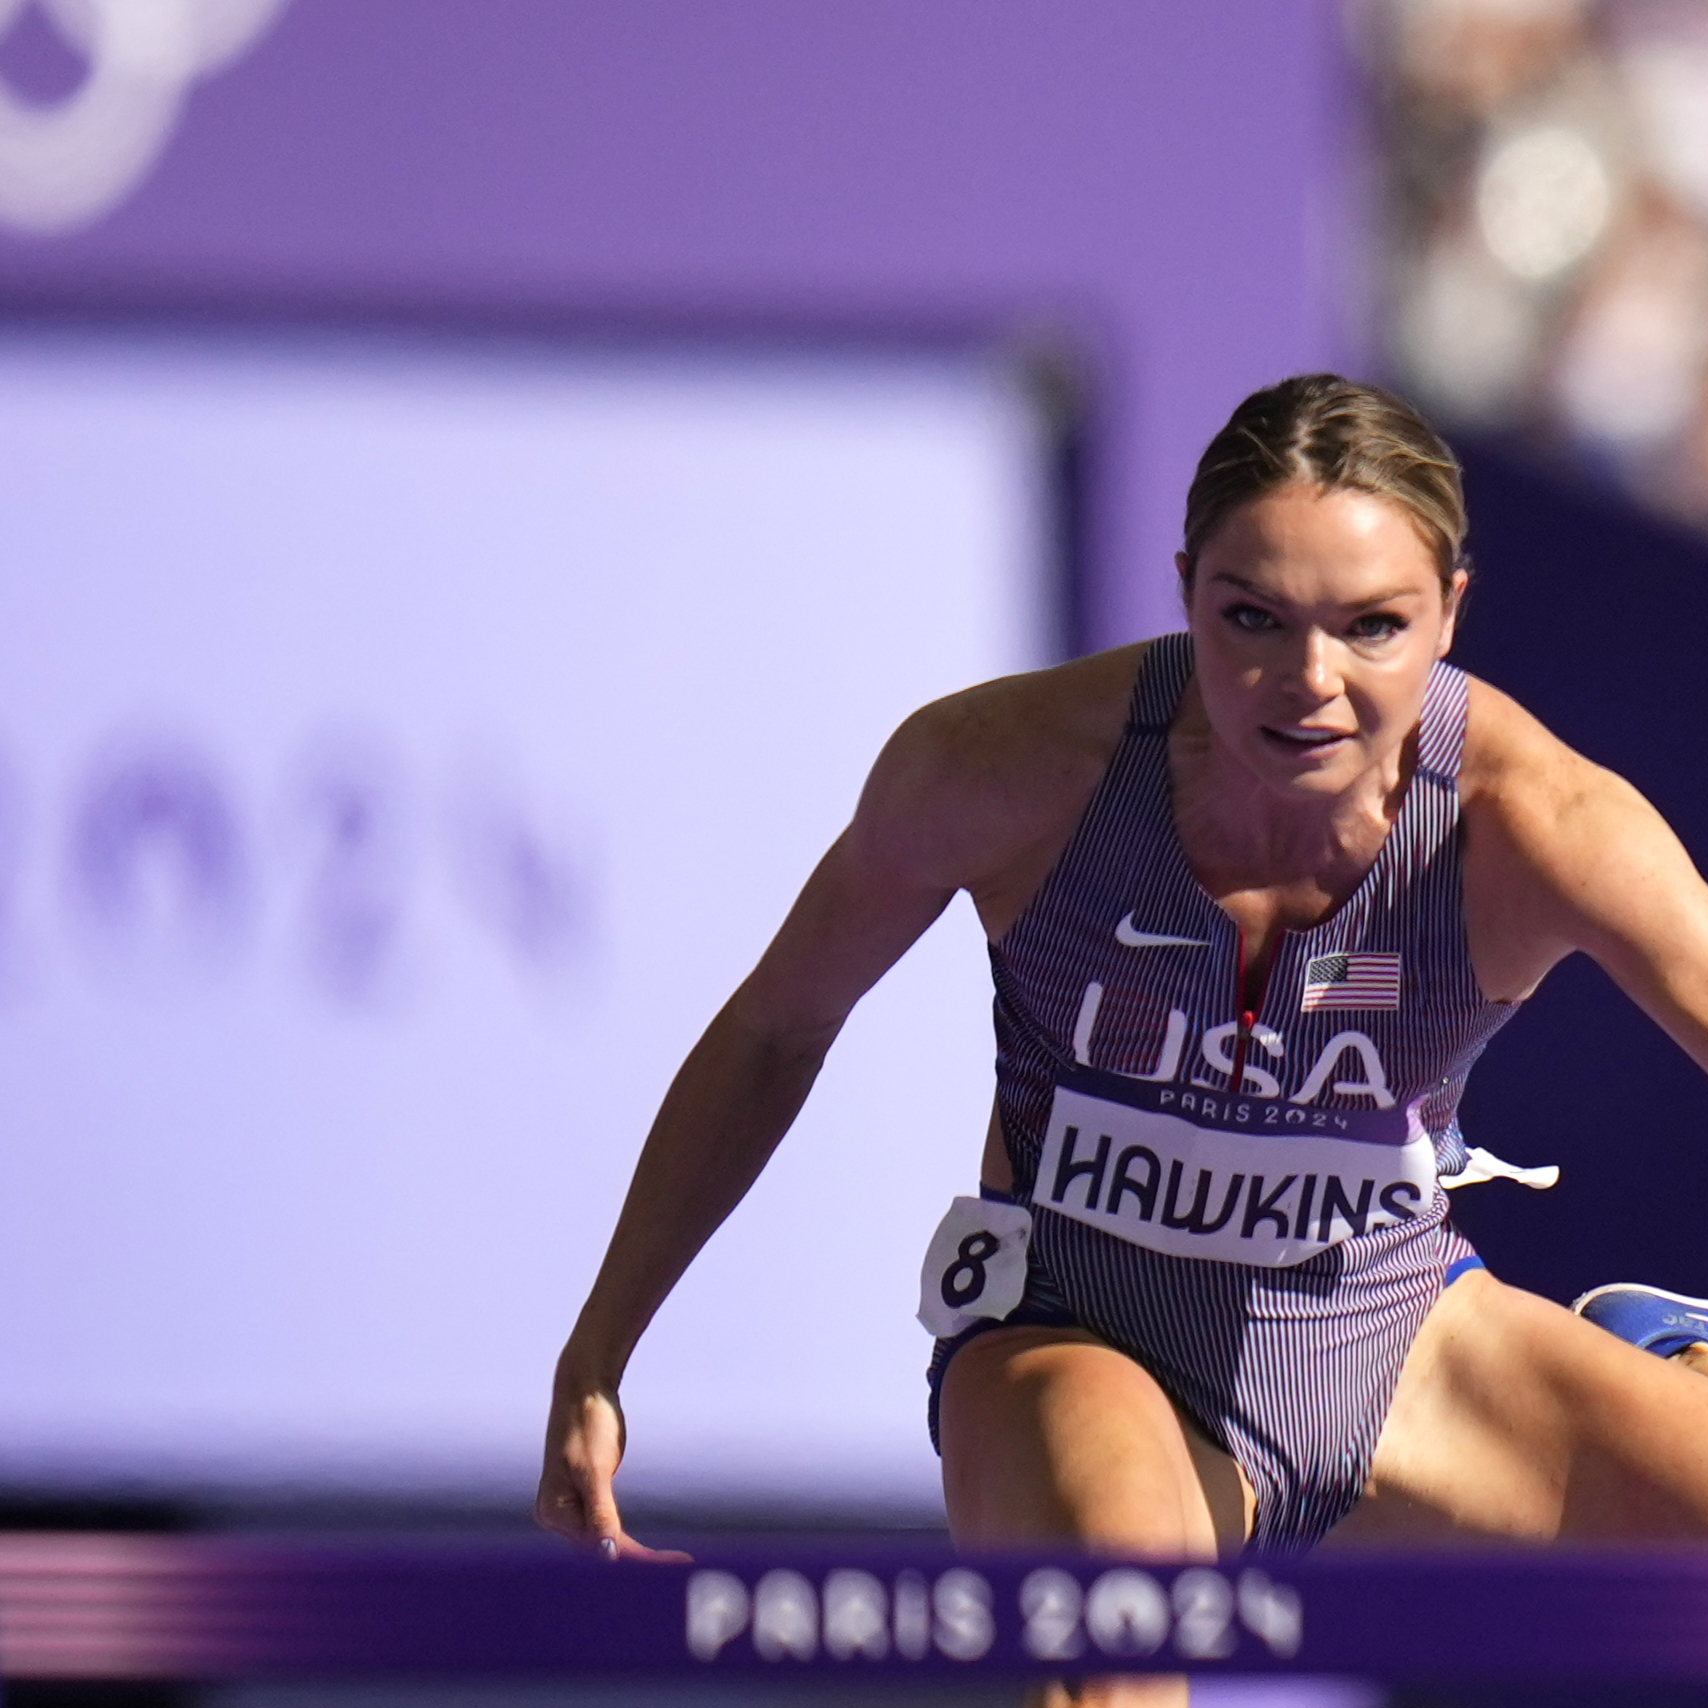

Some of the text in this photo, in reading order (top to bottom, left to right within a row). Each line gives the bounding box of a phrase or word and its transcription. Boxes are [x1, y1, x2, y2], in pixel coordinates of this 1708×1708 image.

[1073, 980, 1396, 1110] USA
[1264, 1105, 1348, 1131] 2024
[1050, 1124, 1421, 1243] HAWKINS
[941, 1229, 1000, 1310] 8
[1018, 1567, 1302, 1661] 2024
